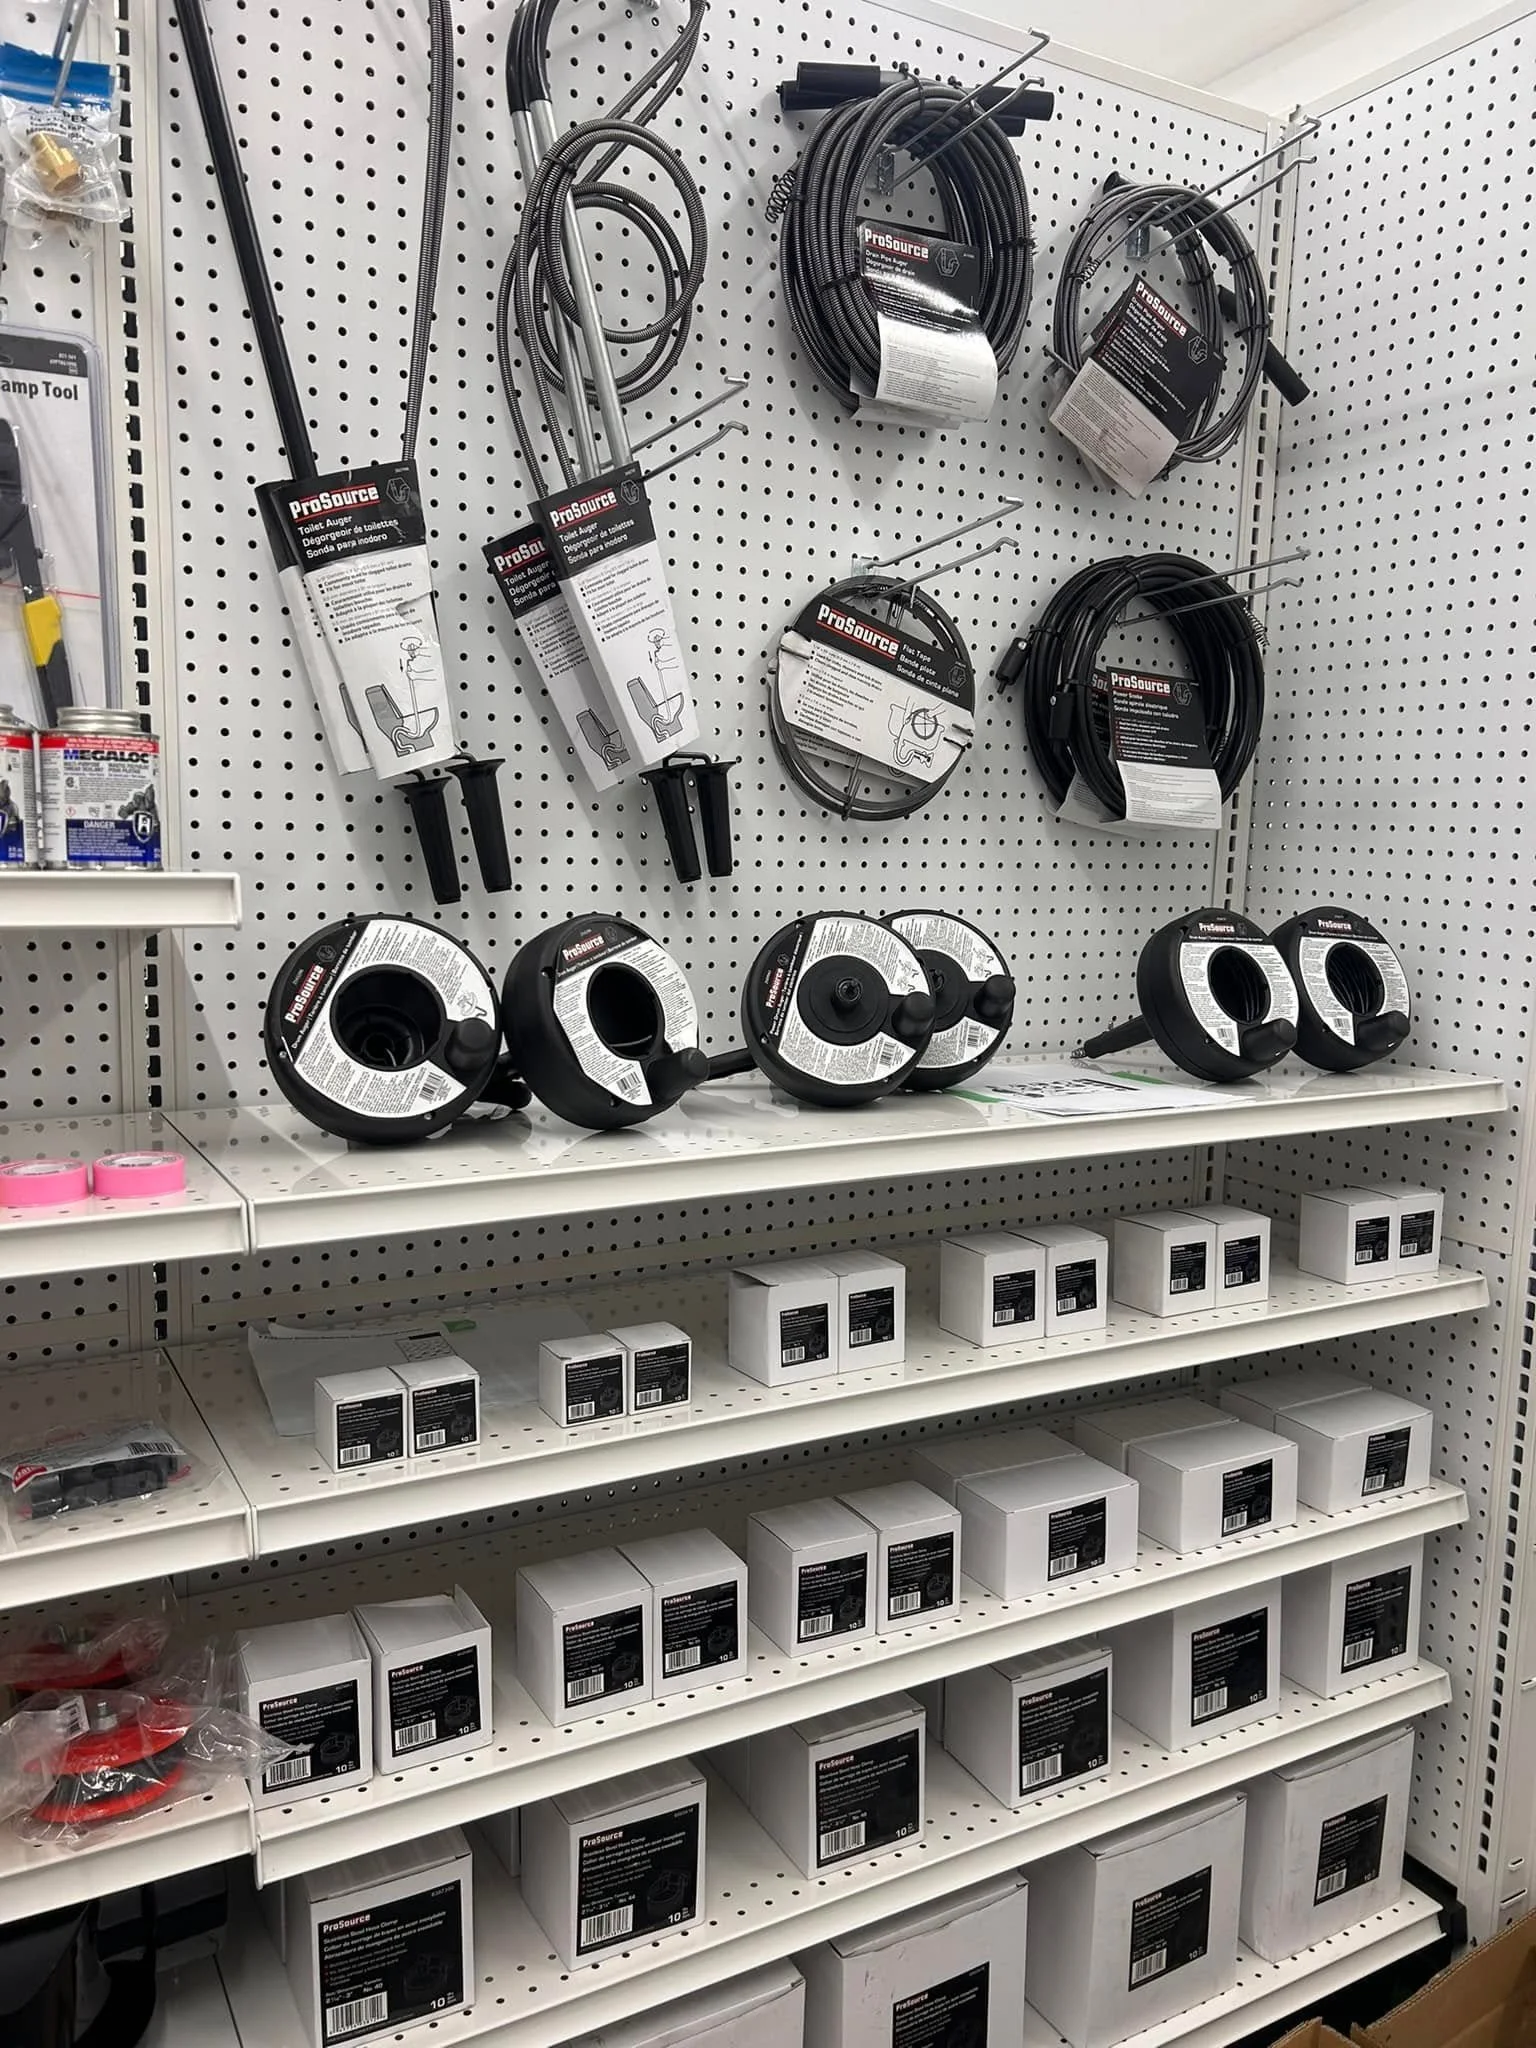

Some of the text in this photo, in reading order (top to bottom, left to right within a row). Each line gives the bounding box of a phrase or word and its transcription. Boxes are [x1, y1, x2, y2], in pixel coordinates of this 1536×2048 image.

[865, 228, 928, 259] ProSource
[1135, 280, 1187, 337] ProSource
[42, 381, 78, 400] Tool
[289, 486, 379, 519] ProSource
[550, 491, 617, 528] ProSource
[298, 515, 353, 536] Toilet Auger
[302, 519, 399, 547] Dégorgeoir de toilettes
[559, 522, 598, 543] Toilet Auger
[306, 533, 388, 559] Sonda para inodoro
[563, 519, 635, 554] Dégorgeoir de toilettes
[567, 533, 628, 565] Sonda para inodoro
[504, 561, 549, 587] Toilet Auger
[509, 574, 550, 597] Dégorgeoir
[513, 582, 556, 606] Sonda para
[817, 604, 899, 656] ProSource
[903, 644, 932, 663] Flat Tape
[900, 654, 936, 677] Bande plate
[897, 665, 960, 698] Sonda de cinta plana
[1111, 672, 1170, 694] ProSource
[63, 749, 149, 764] MEGALOC
[83, 821, 115, 829] DANGER
[1198, 922, 1235, 933] ProSource
[561, 932, 605, 961] ProSource
[284, 963, 325, 1024] ProSource
[765, 967, 785, 1008] ProSource
[291, 1033, 303, 1050] Drum
[298, 1018, 313, 1036] Auger
[849, 1622, 857, 1630] 10
[719, 1653, 728, 1662] 10
[391, 1663, 423, 1679] ProSource
[623, 1679, 633, 1689] 10
[262, 1696, 297, 1711] ProSource
[1250, 1694, 1258, 1703] 10
[458, 1725, 469, 1735] 10
[335, 1763, 347, 1774] 10
[819, 1751, 854, 1771] ProSource
[1088, 1759, 1097, 1768] 10
[582, 1828, 623, 1848] ProSource
[895, 1826, 907, 1838] 10
[322, 1911, 370, 1934] ProSource
[667, 1910, 681, 1924] 10
[1189, 1950, 1198, 1960] 10
[429, 1995, 445, 2011] 10
[896, 1993, 929, 2012] ProSource
